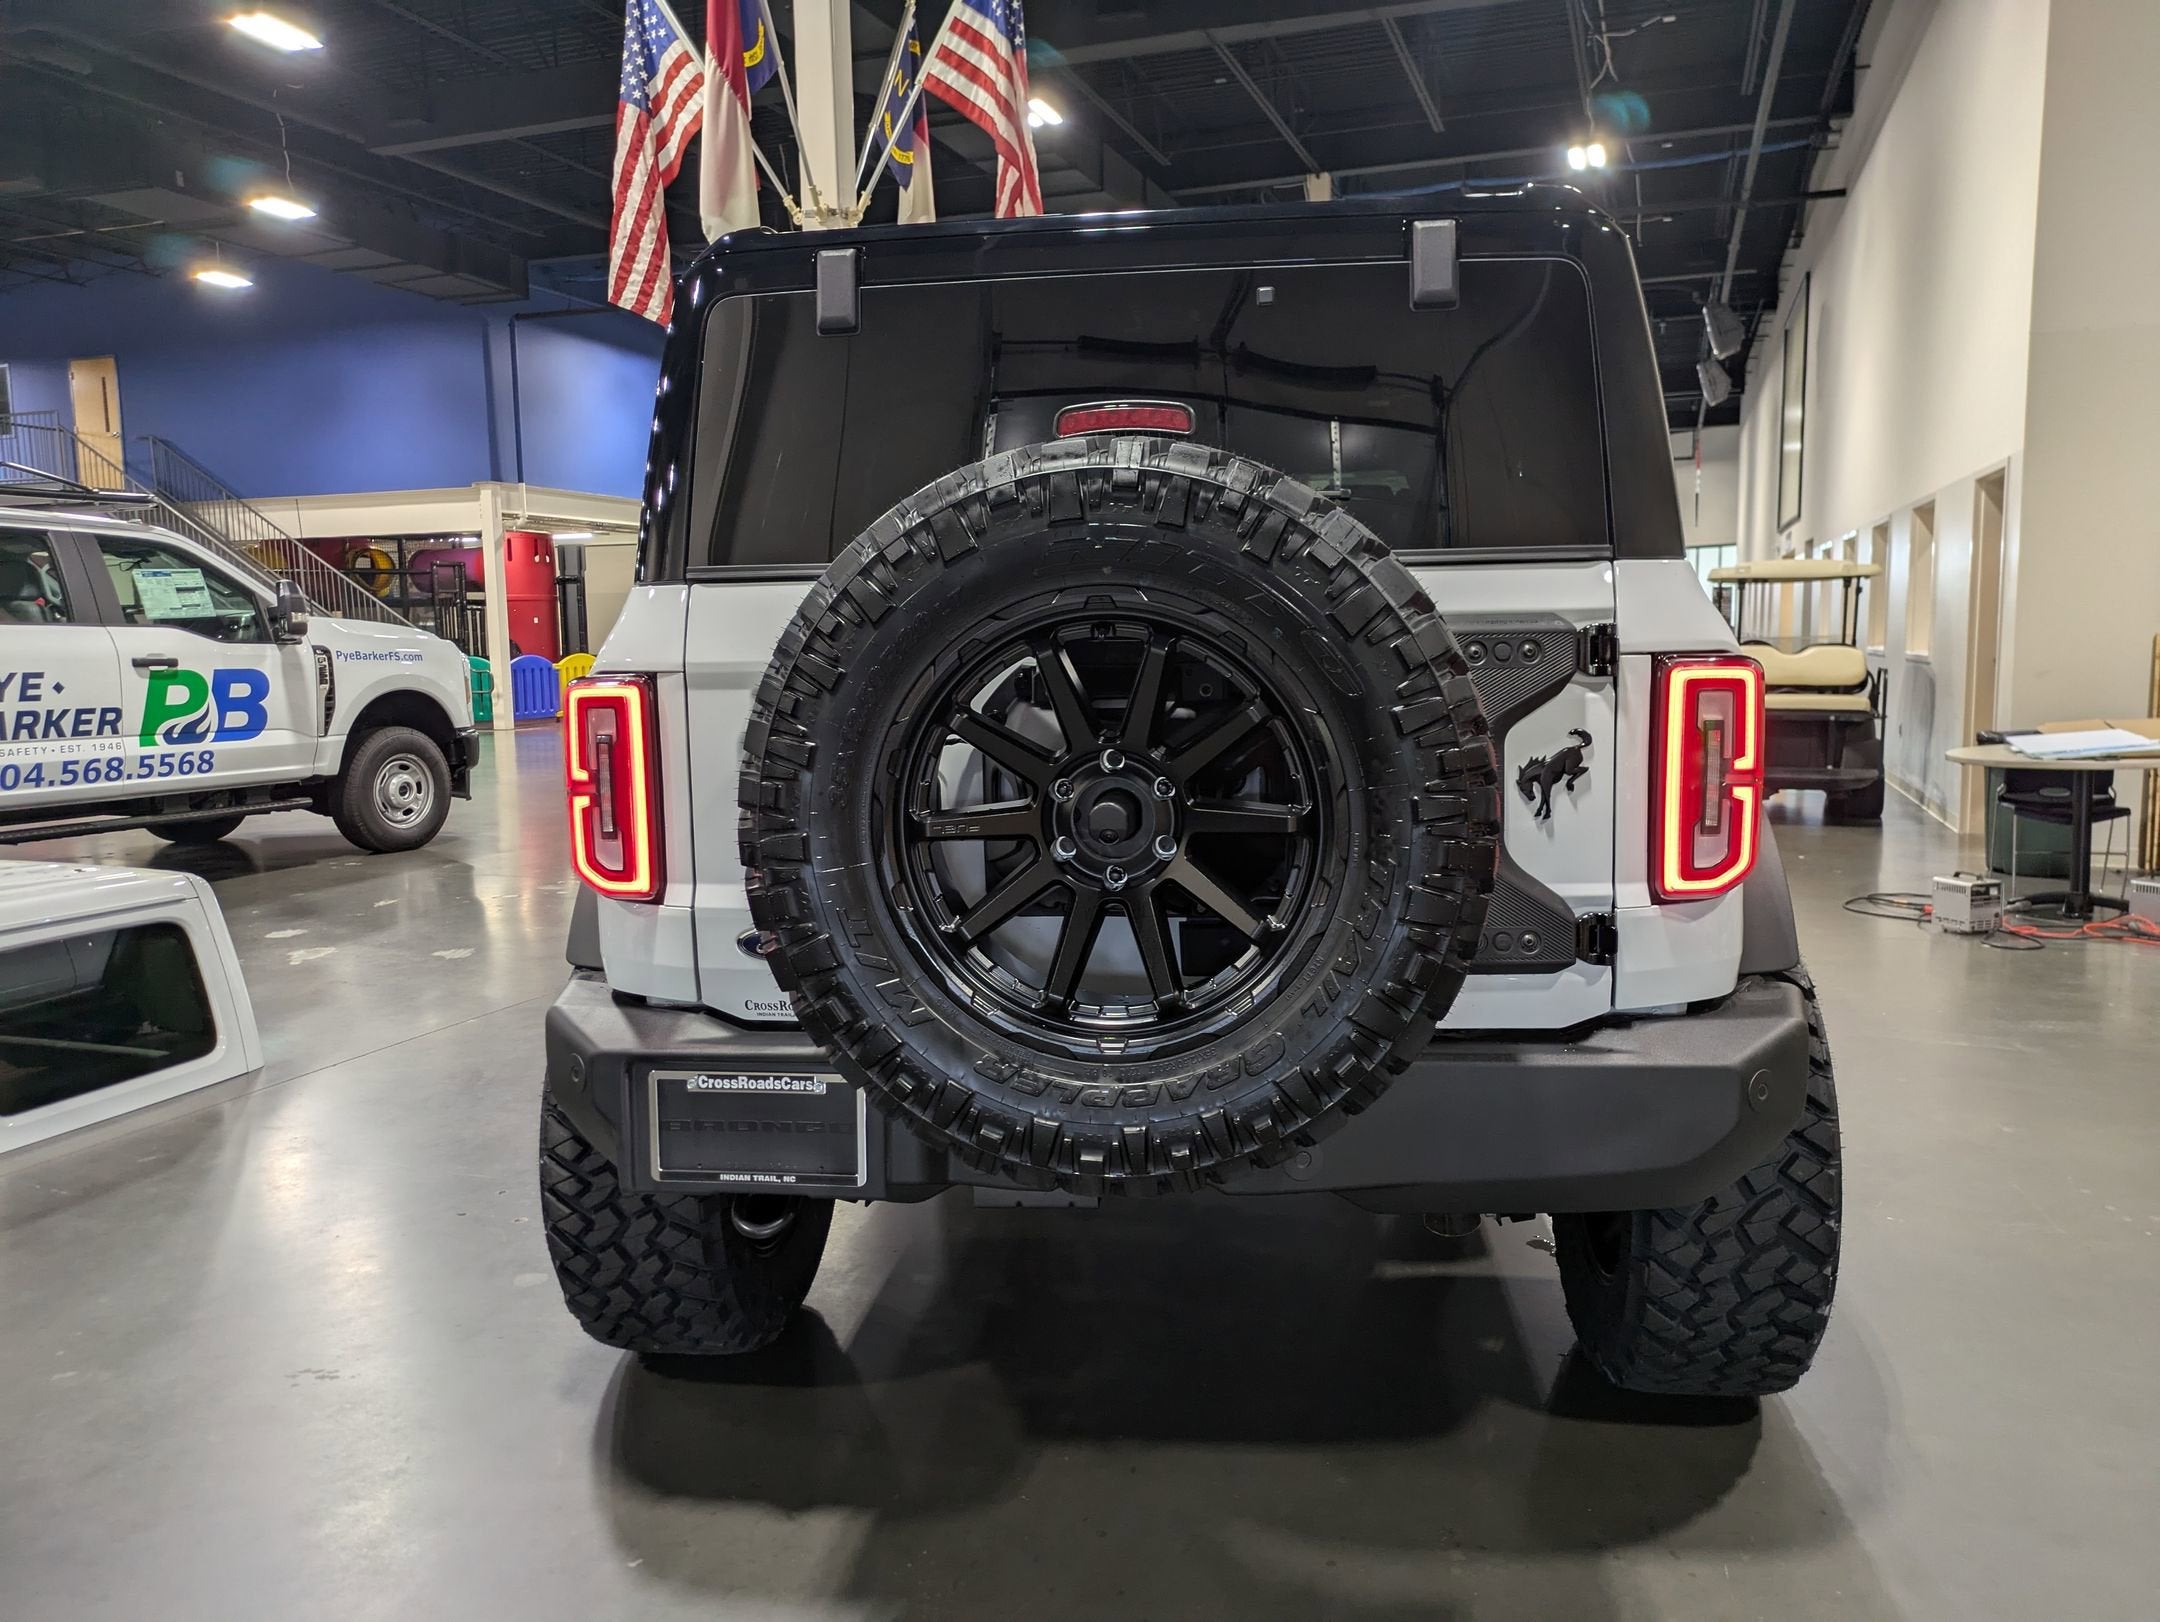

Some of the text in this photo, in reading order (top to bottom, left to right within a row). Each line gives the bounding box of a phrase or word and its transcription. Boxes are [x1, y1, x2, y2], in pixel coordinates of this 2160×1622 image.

[335, 650, 424, 662] PyeBarkerFS.com
[60, 744, 86, 754] EST.
[92, 742, 122, 752] 1946
[0, 751, 214, 791] 04.568.5568
[978, 1031, 1288, 1110] GRAPPLER
[720, 1173, 796, 1184] INDIAN TRAIL, NC
